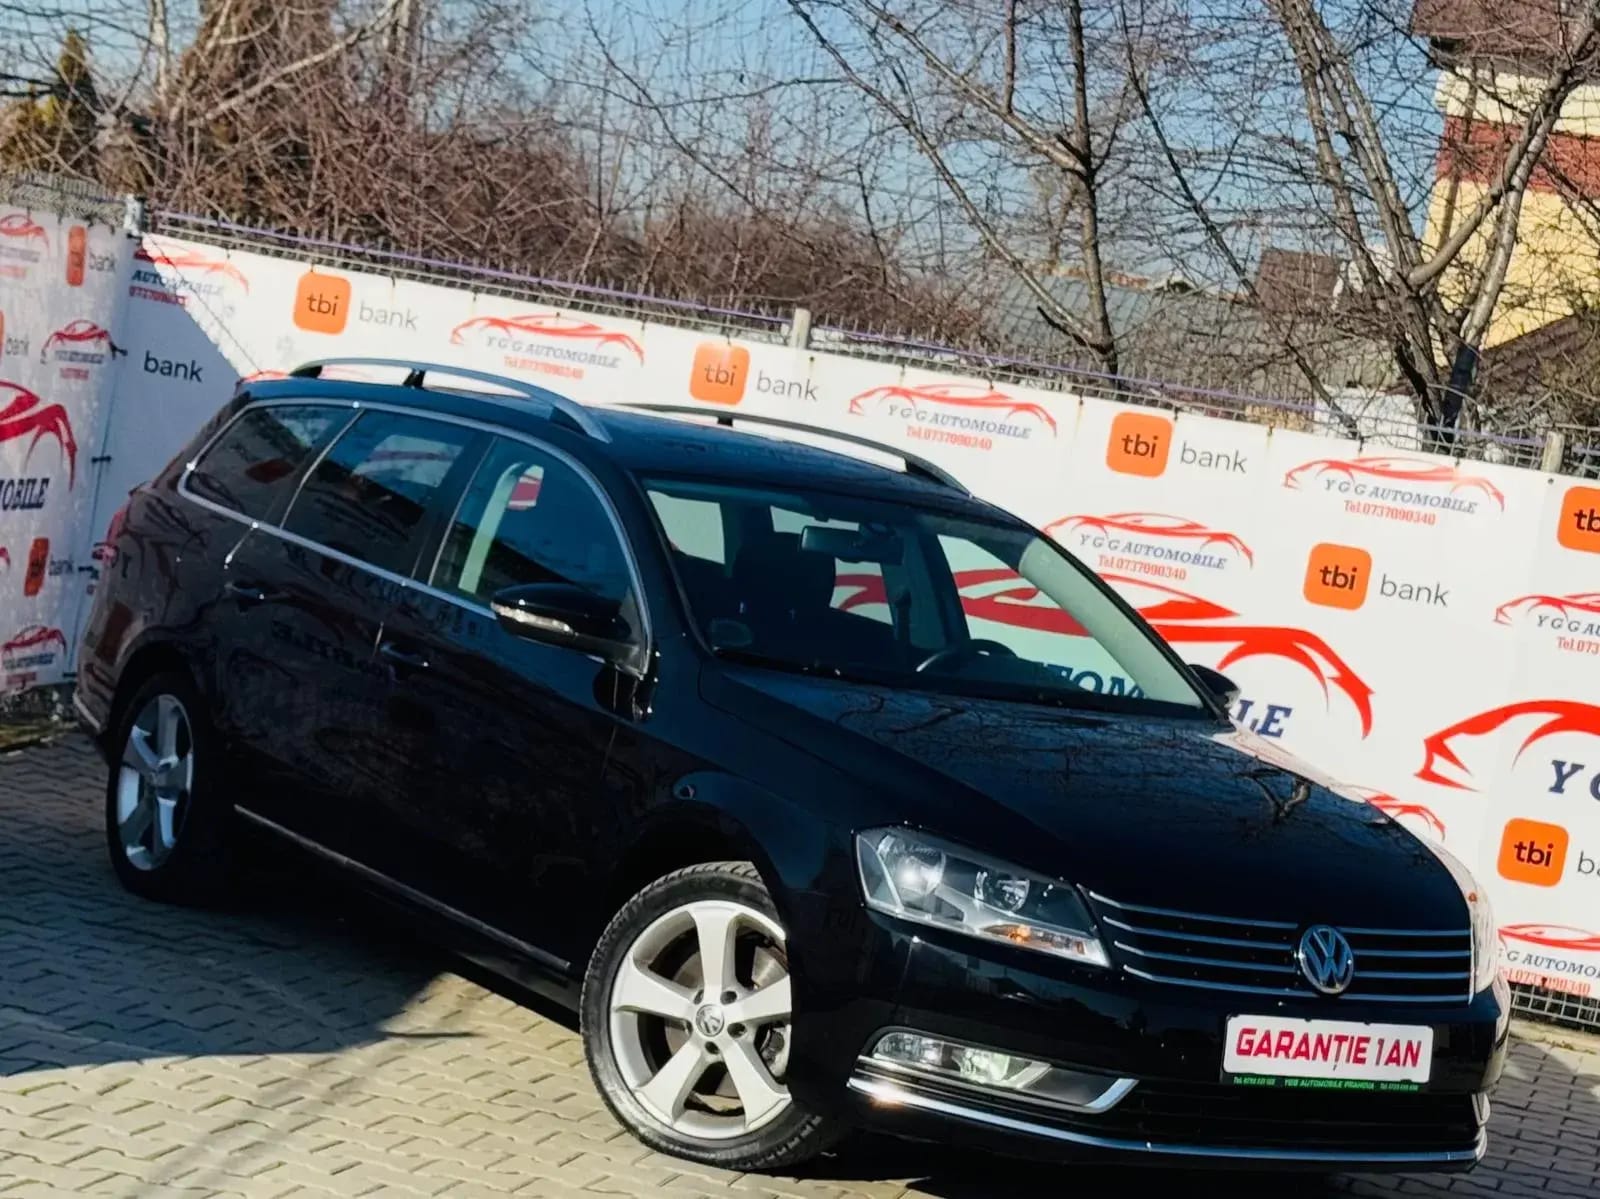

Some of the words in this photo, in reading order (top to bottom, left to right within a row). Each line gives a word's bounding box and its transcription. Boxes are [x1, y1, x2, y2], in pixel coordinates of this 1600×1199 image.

[306, 293, 340, 317] tbi
[359, 300, 418, 330] bank
[144, 350, 203, 383] bank
[523, 343, 621, 369] AUTOMOBILE
[704, 362, 738, 387] tbi
[756, 370, 818, 401] bank
[888, 404, 898, 416] Y
[900, 407, 913, 419] G
[916, 410, 928, 422] G
[929, 412, 1032, 439] AUTOMOBILE
[1121, 433, 1159, 459] tbi
[1179, 440, 1248, 474] bank
[1325, 479, 1336, 491] Y
[1338, 481, 1351, 493] G
[1354, 483, 1367, 496] G
[1368, 486, 1478, 514] AUTOMOBILE
[1080, 533, 1091, 546] Y
[1092, 536, 1105, 548] G
[1108, 539, 1121, 551] G
[1122, 541, 1228, 570] AUTOMOBILE
[1319, 564, 1358, 591] tbi
[1379, 573, 1449, 608] bank
[1536, 615, 1550, 628] Y
[1551, 617, 1565, 630] G
[1567, 620, 1581, 633] G
[1548, 759, 1585, 795] Y
[1513, 840, 1555, 868] tbi
[1236, 1028, 1371, 1071] GARANȚIE
